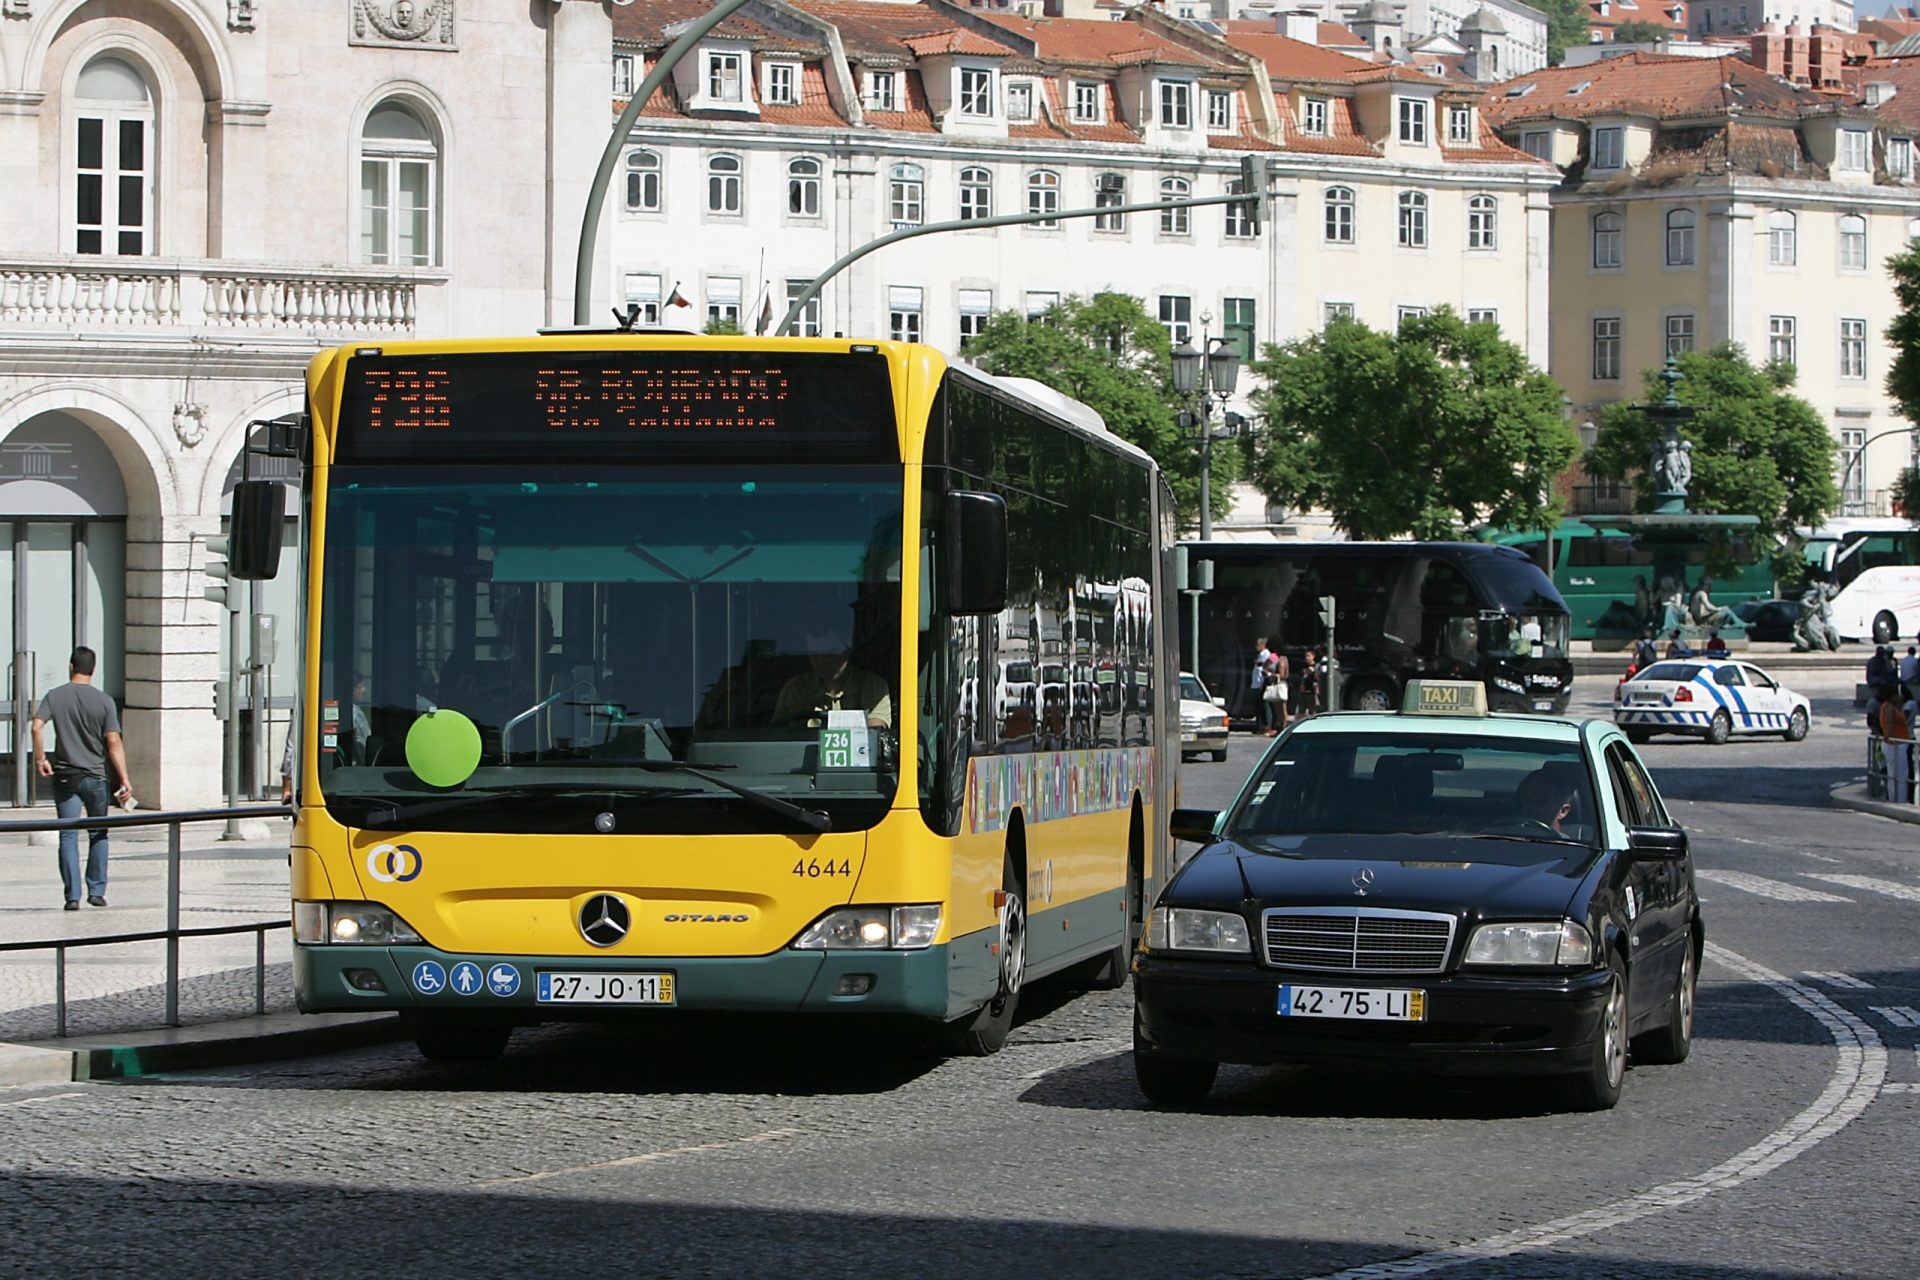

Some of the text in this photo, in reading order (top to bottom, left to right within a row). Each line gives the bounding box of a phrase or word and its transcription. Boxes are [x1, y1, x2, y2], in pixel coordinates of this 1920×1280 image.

[365, 371, 450, 426] 736
[1422, 687, 1458, 703] TAXI
[824, 733, 849, 748] 736
[829, 752, 844, 765] 14
[792, 858, 851, 878] 4644
[660, 978, 671, 987] 10
[659, 991, 671, 1000] 07
[1410, 1009, 1421, 1017] 06
